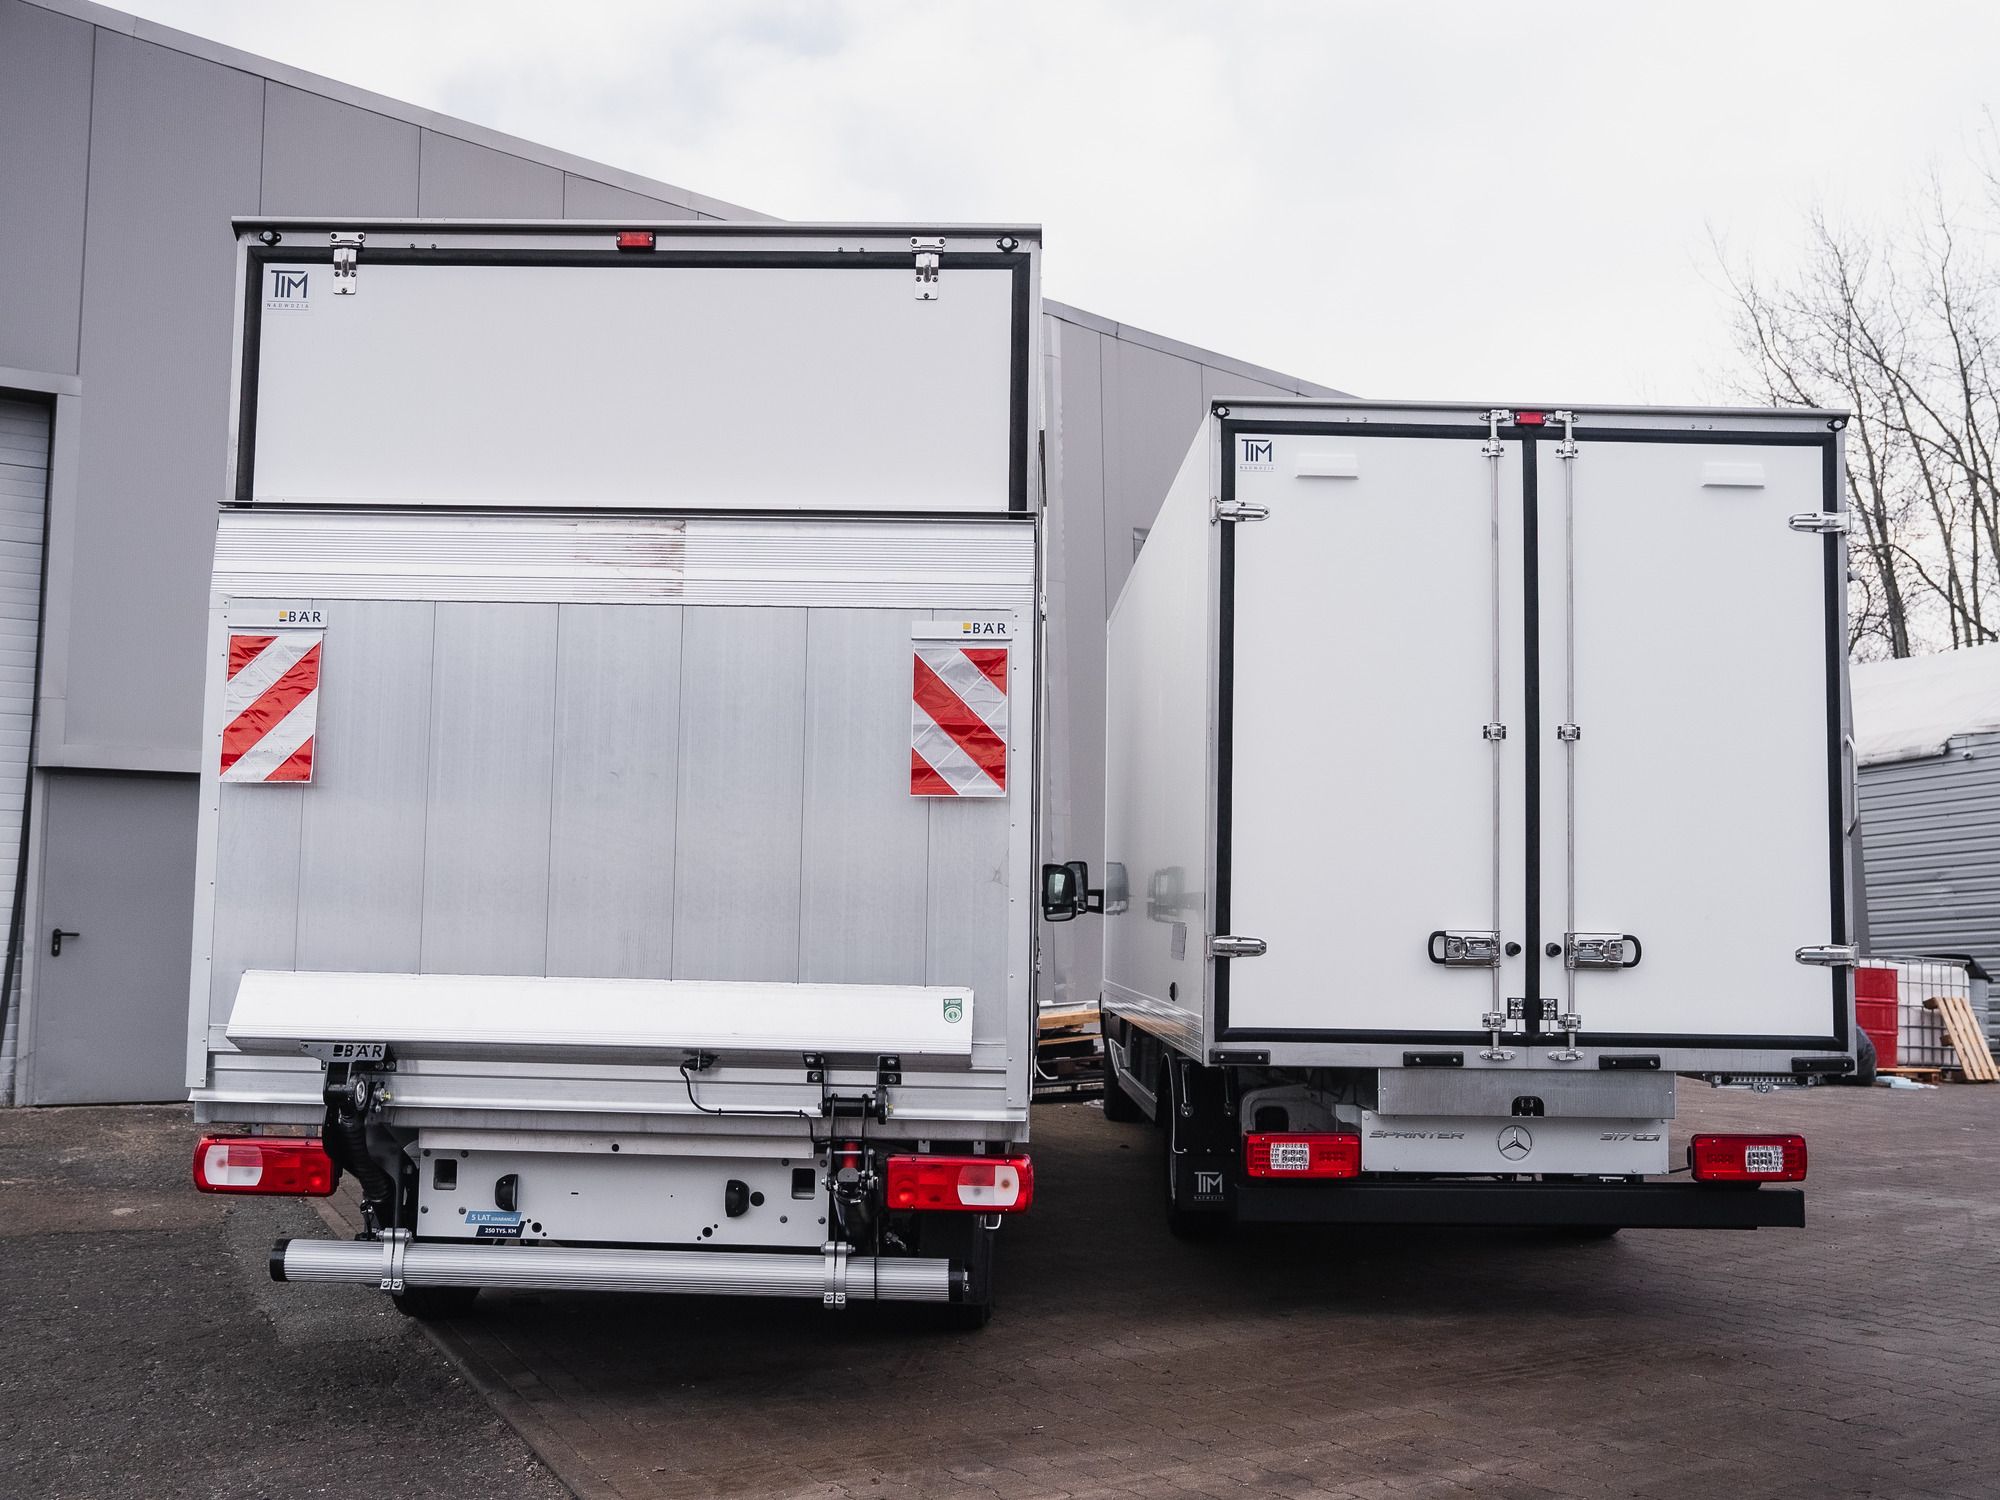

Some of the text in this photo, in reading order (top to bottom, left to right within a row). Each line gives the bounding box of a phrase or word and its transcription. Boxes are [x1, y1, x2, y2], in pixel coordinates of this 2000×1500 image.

[271, 270, 308, 298] TIM
[1241, 439, 1272, 462] TIM
[289, 611, 321, 622] BÄR
[973, 623, 1006, 634] BÄR
[344, 1045, 382, 1057] BÄR
[1369, 1131, 1465, 1140] SPRINTER
[1600, 1132, 1630, 1140] 317
[1194, 1171, 1223, 1193] TIM
